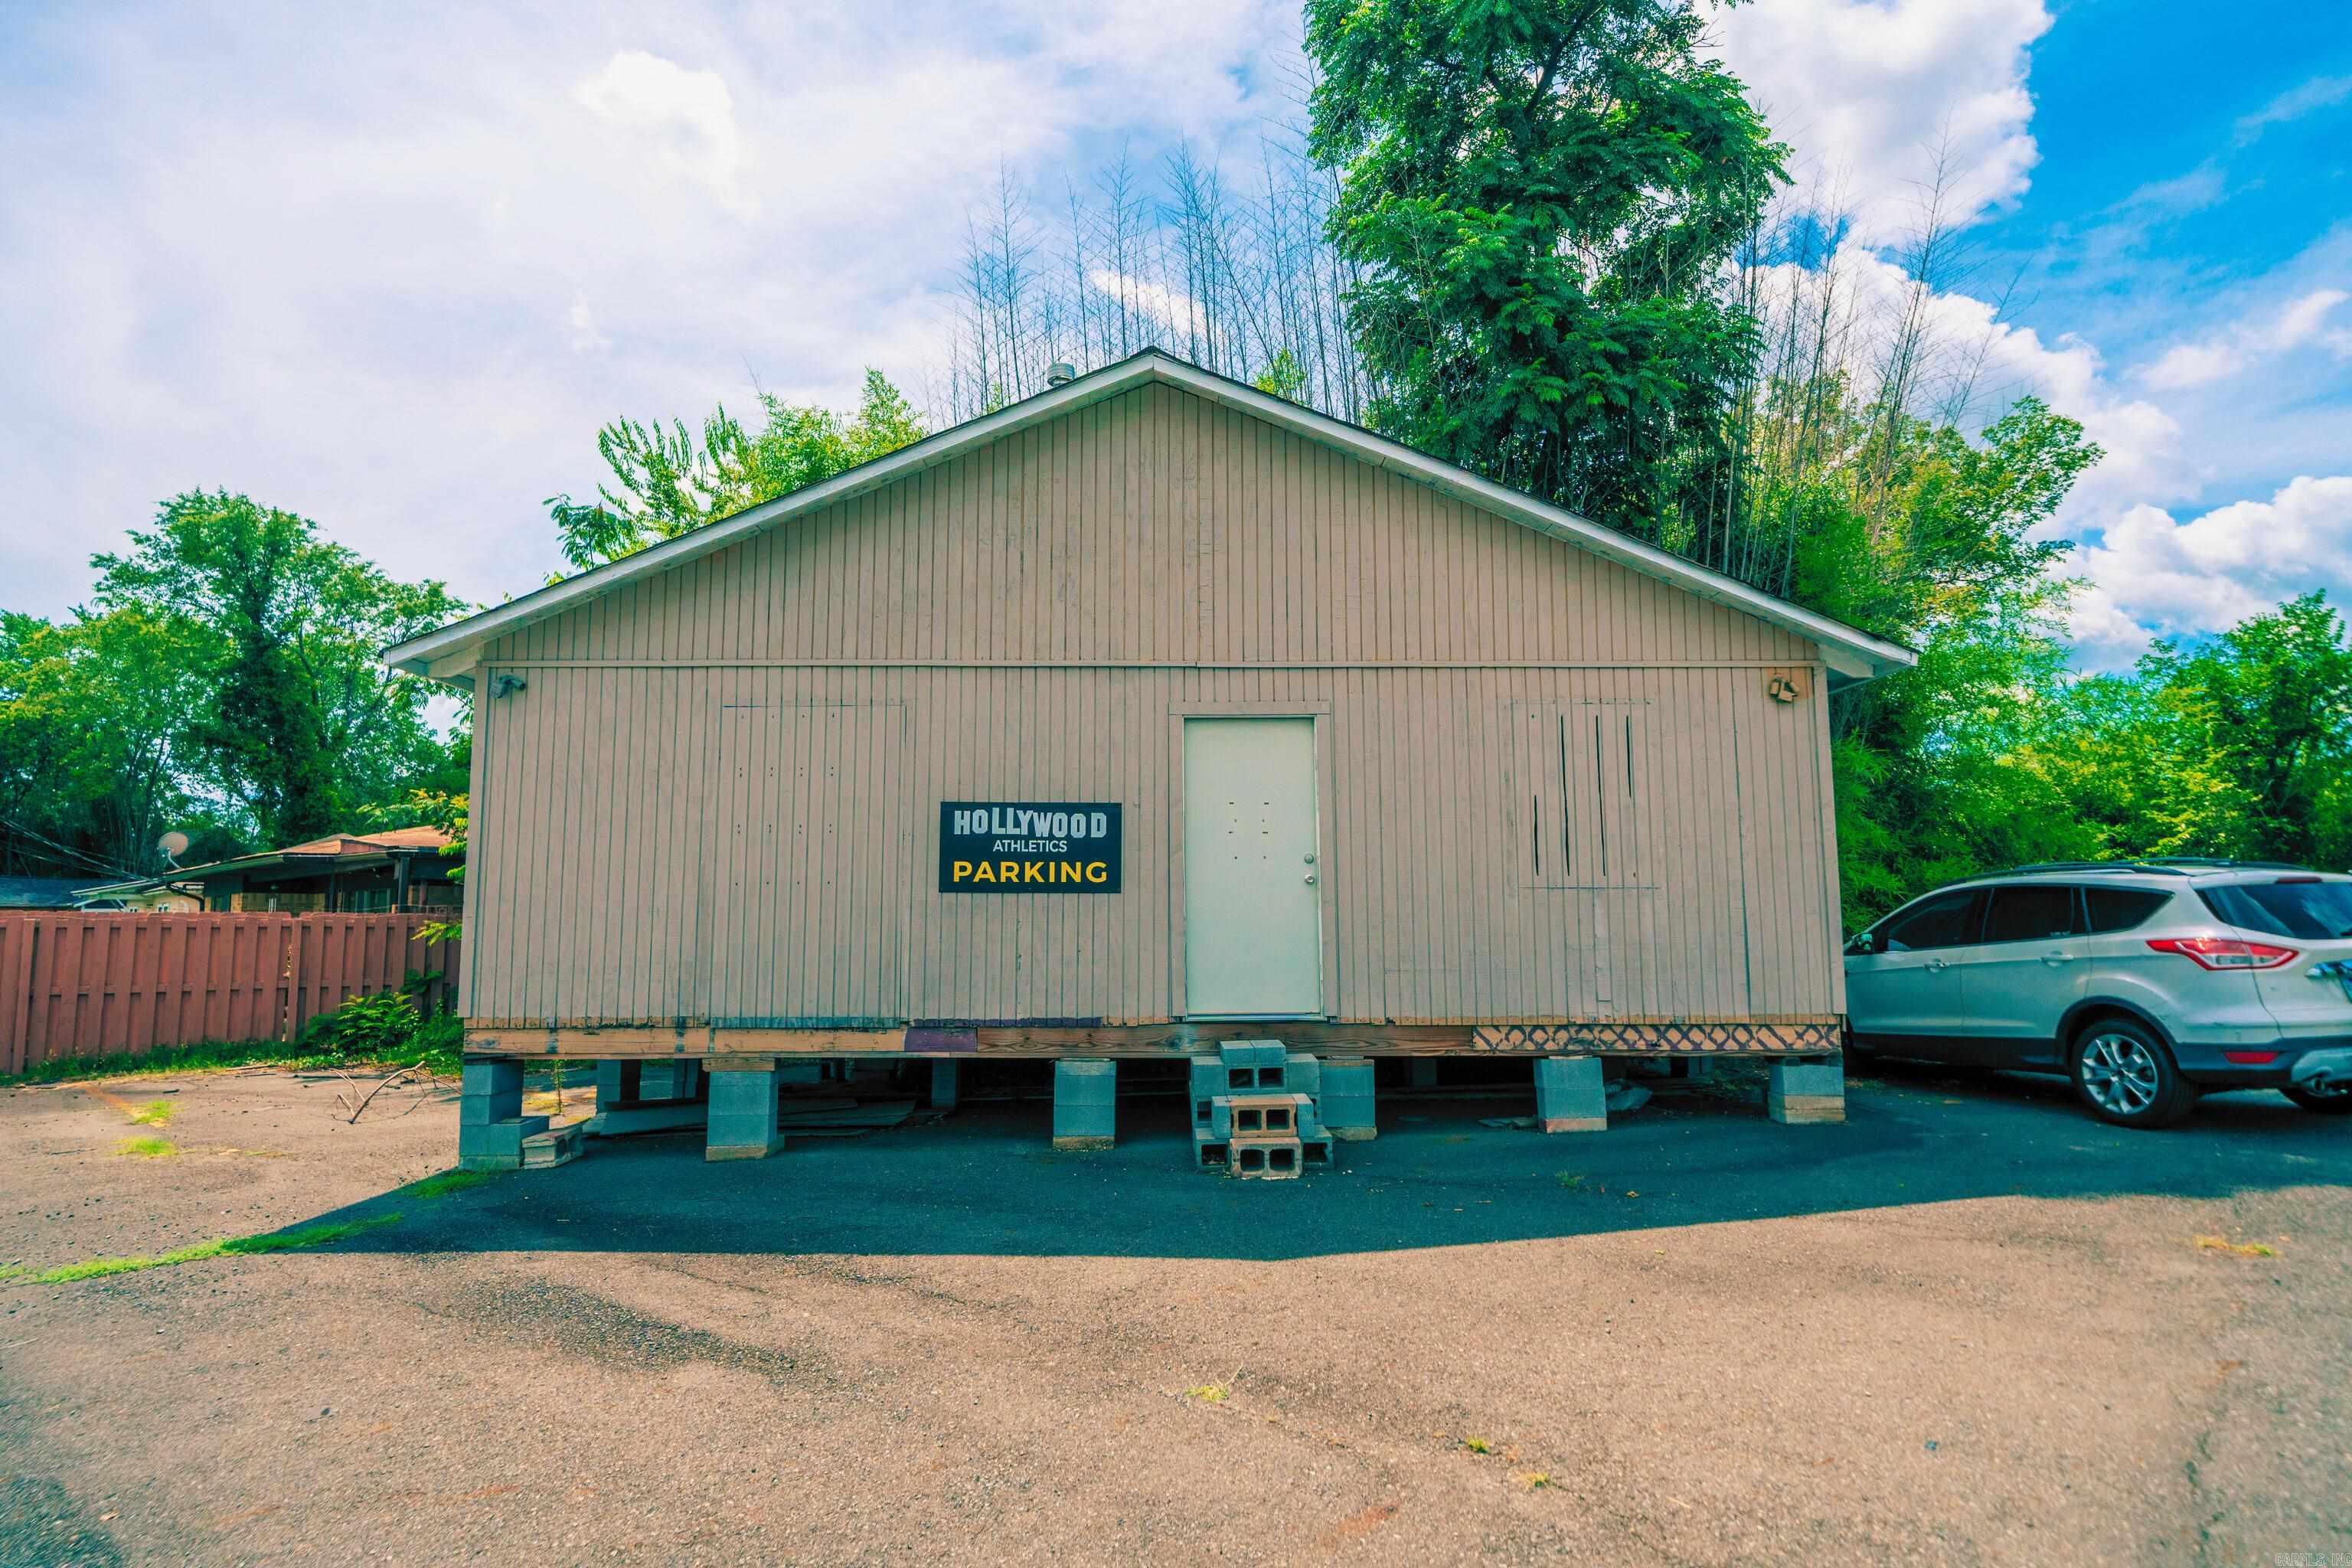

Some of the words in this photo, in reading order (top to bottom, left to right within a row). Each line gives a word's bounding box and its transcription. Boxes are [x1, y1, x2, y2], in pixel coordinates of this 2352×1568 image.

[954, 808, 1107, 838] HOLLYWOOD
[993, 840, 1067, 852] ATHLETICS
[953, 861, 1108, 883] PARKING
